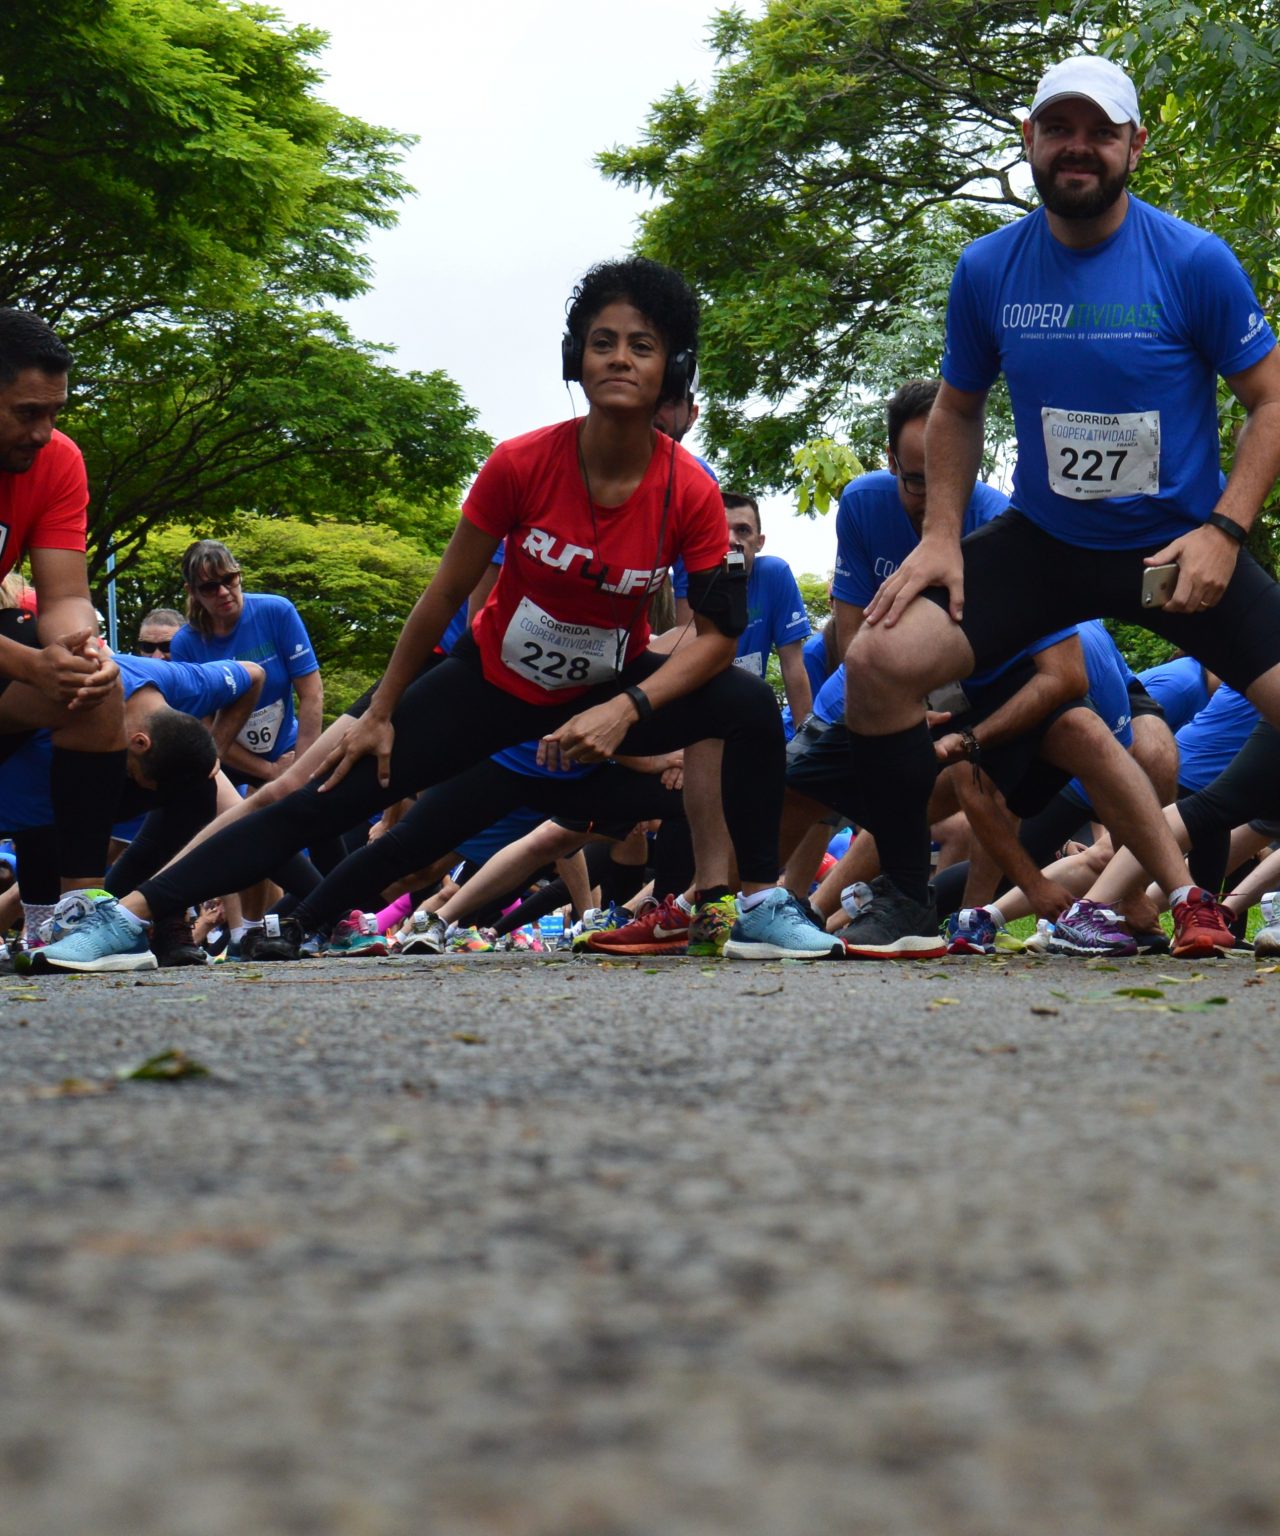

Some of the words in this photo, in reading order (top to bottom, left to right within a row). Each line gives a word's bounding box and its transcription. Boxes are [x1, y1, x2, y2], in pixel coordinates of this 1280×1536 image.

[1067, 412, 1120, 426] CORRIDA
[1051, 424, 1138, 442] COOPERATIVIDADE
[1060, 446, 1128, 482] 227
[520, 617, 606, 652] COOPERATIVIDADE
[540, 615, 590, 636] CORRIDA
[519, 641, 590, 681] 228
[246, 726, 272, 746] 96
